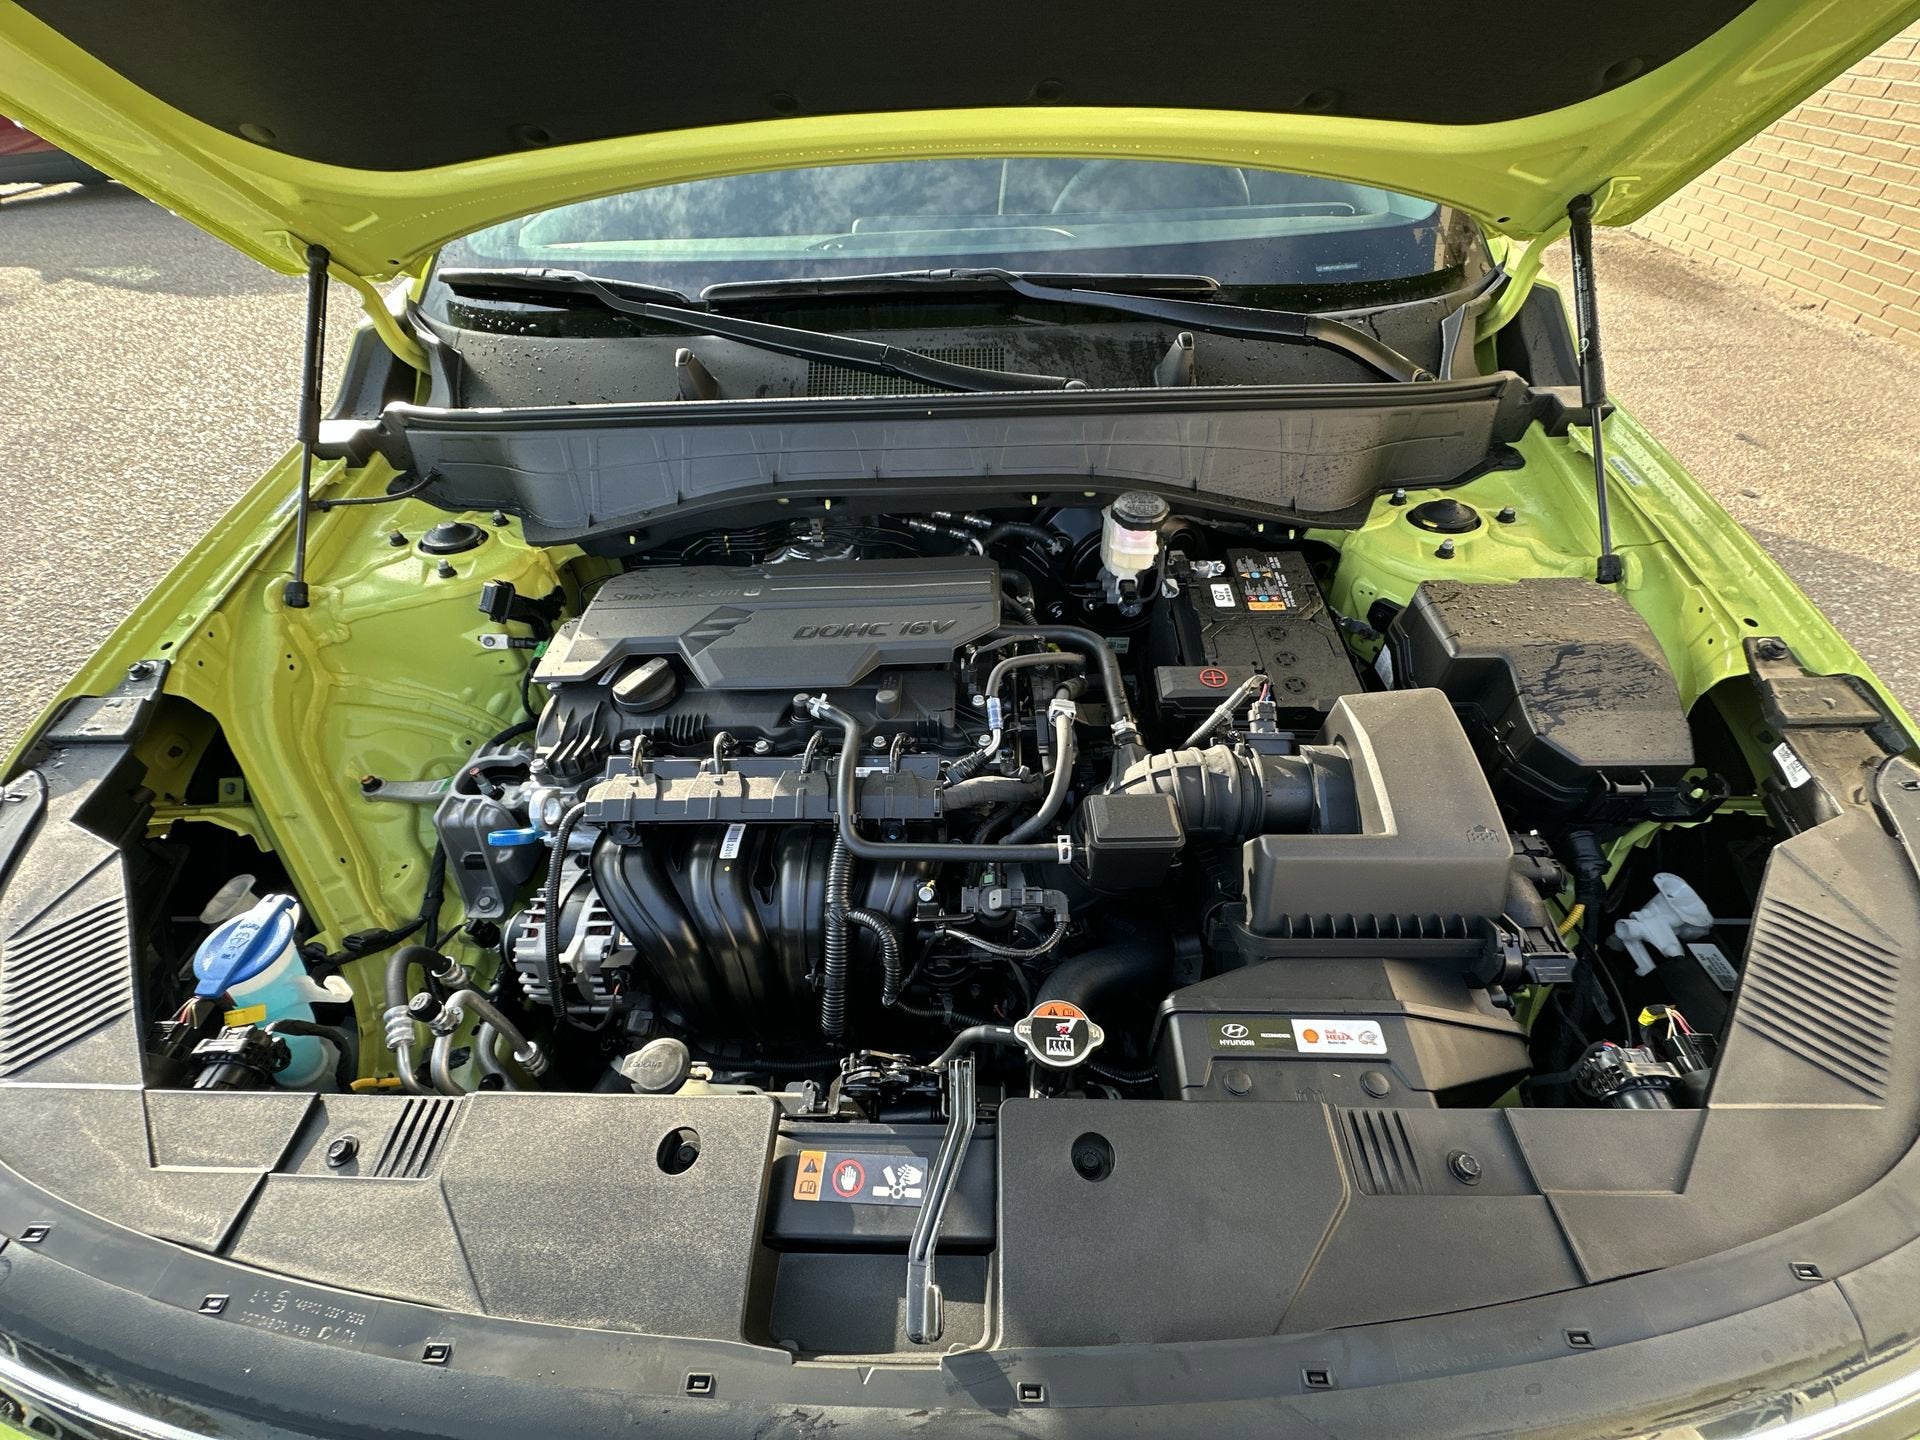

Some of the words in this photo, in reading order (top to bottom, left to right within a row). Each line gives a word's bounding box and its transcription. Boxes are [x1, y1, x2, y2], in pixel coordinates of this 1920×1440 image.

[793, 621, 893, 640] DOHC
[899, 619, 957, 636] 16V
[1326, 1033, 1354, 1041] HELIX
[1219, 1039, 1255, 1047] HYUNDAI
